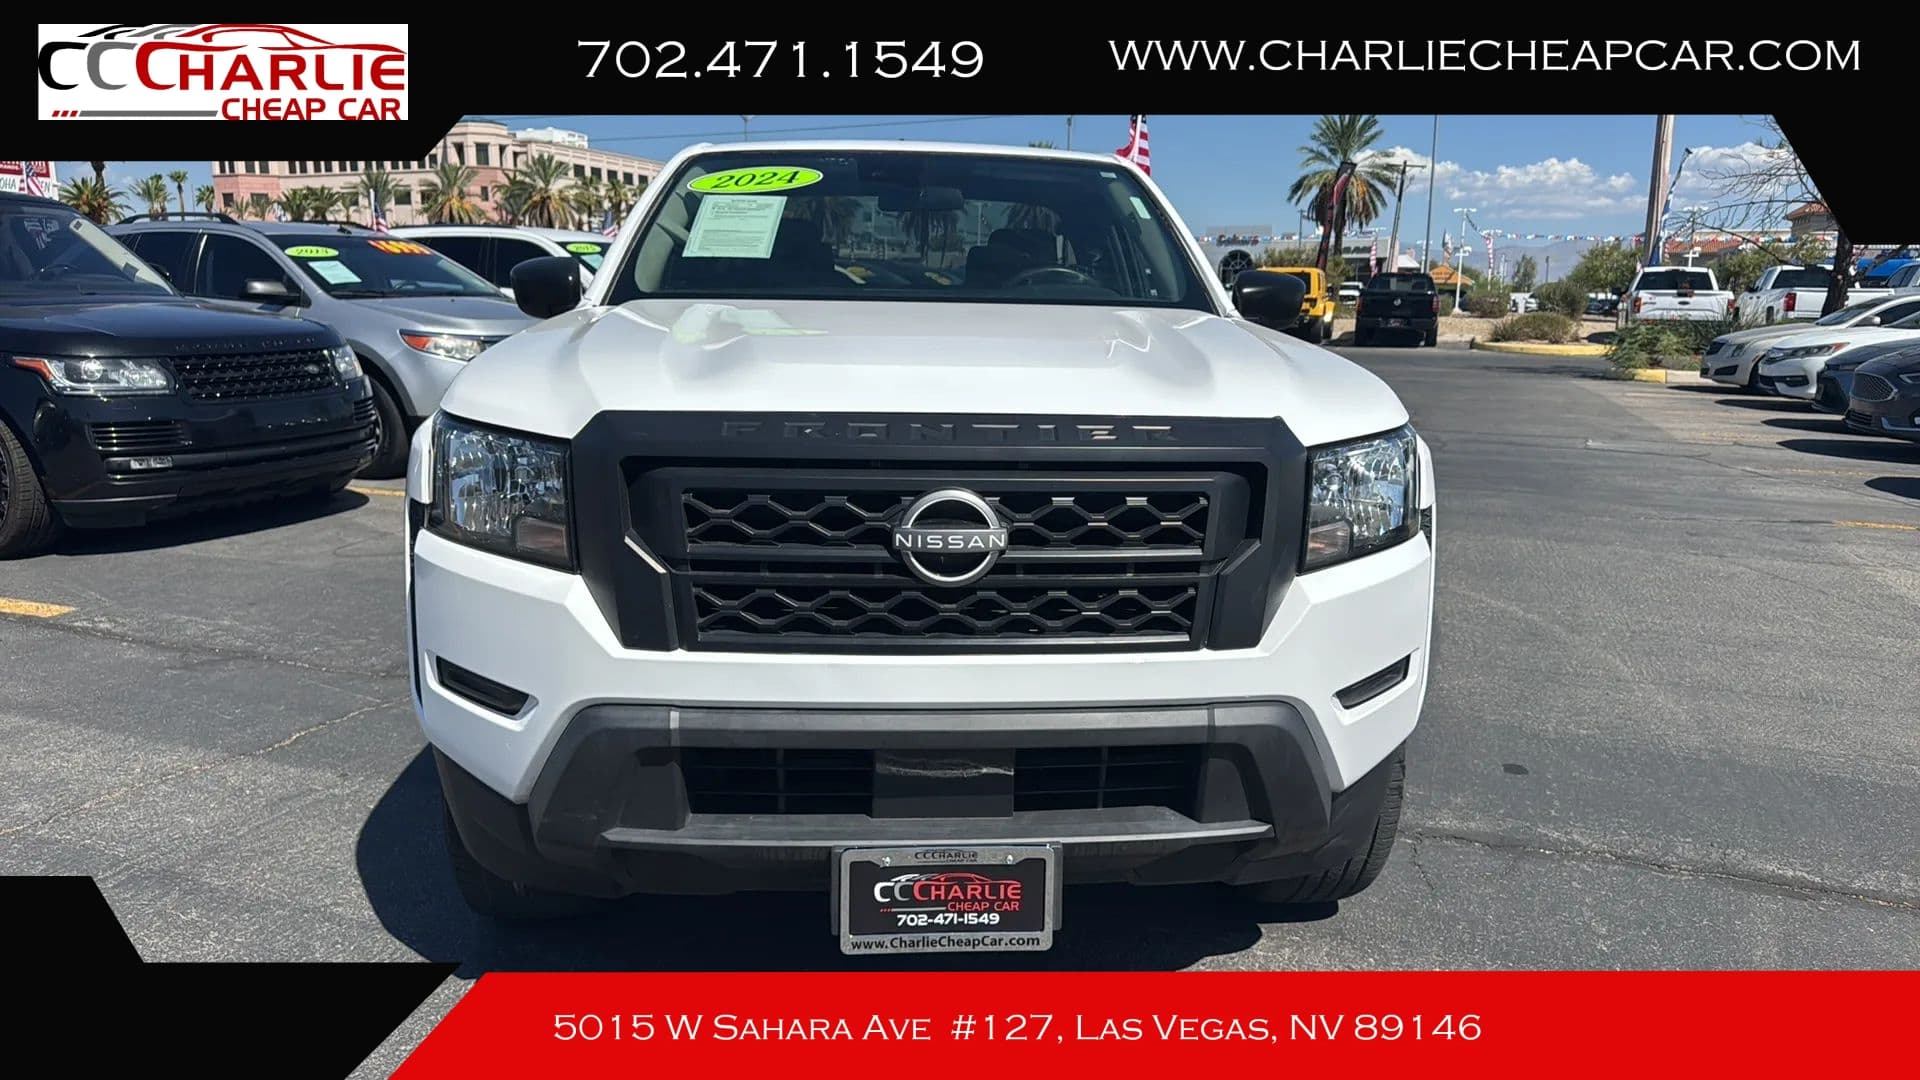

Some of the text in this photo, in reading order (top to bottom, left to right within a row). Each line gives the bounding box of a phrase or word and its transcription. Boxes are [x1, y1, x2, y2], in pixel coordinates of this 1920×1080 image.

[710, 170, 801, 190] 2024
[722, 420, 1179, 442] FRONTIER
[894, 532, 1006, 549] NISSAN
[947, 900, 1020, 913] CHEAP CAR
[896, 912, 1001, 927] 702-471-1549
[850, 935, 1041, 951] www.CharlieCheapCar.com
